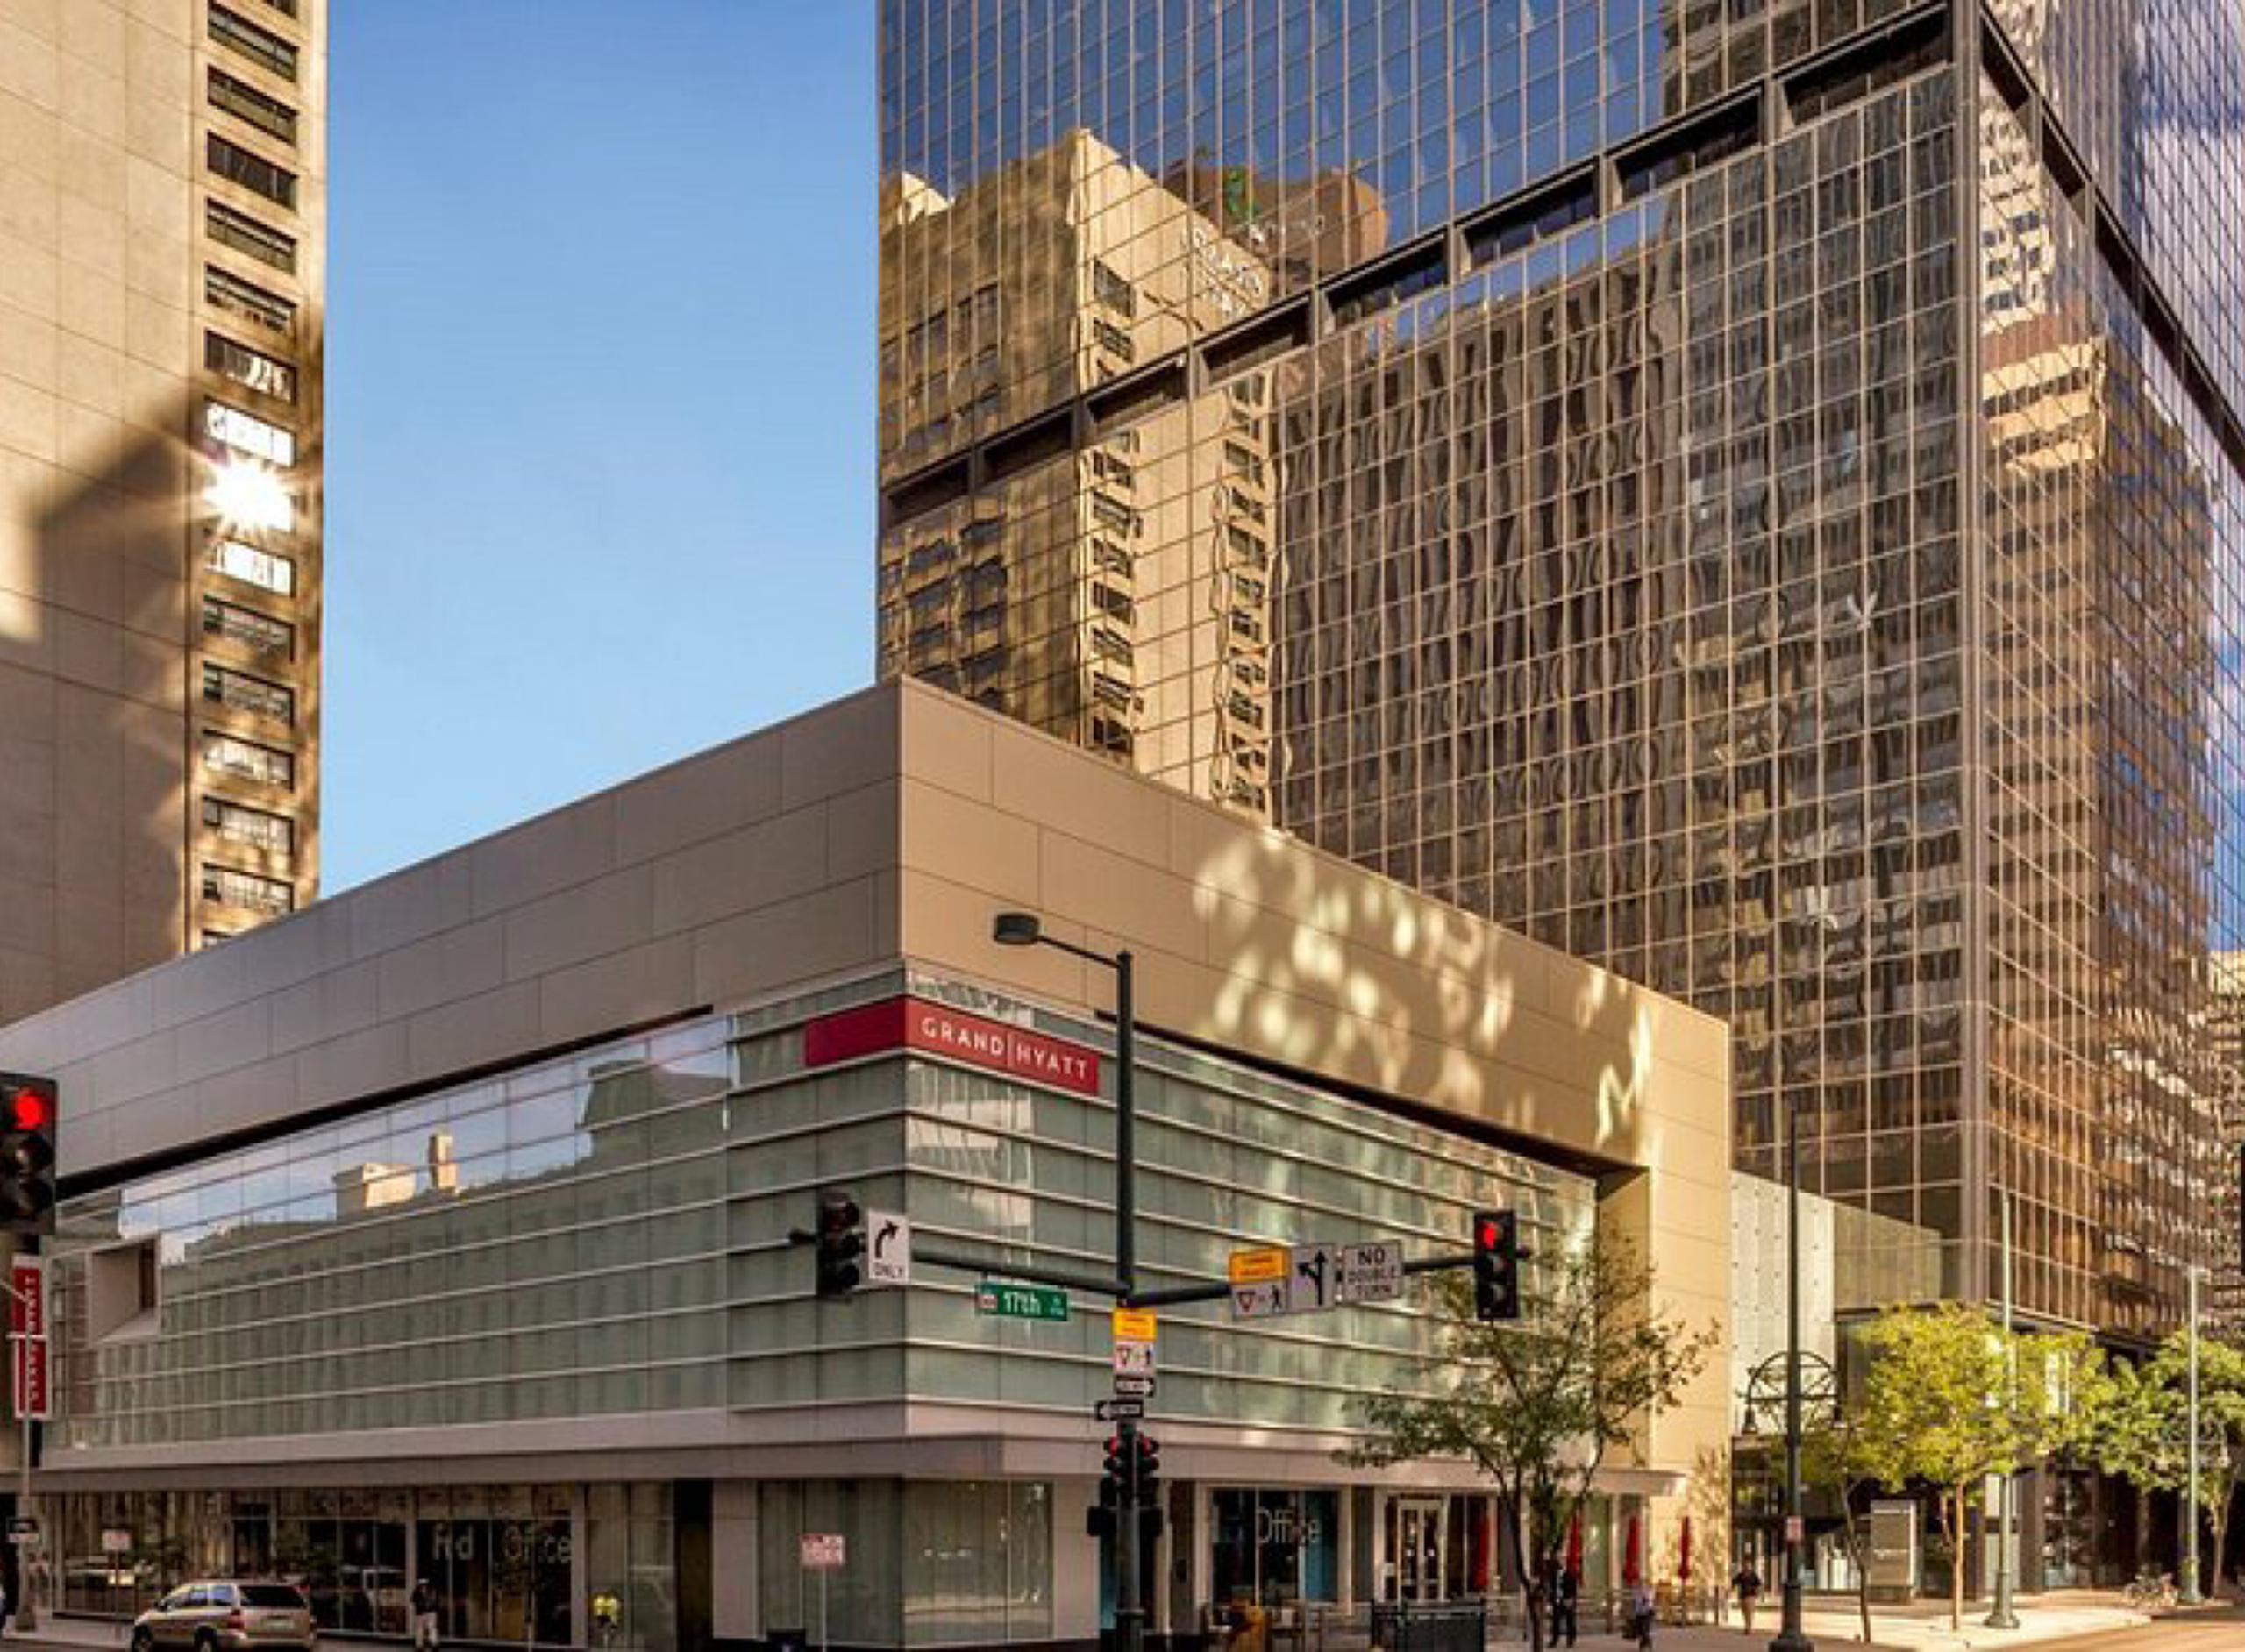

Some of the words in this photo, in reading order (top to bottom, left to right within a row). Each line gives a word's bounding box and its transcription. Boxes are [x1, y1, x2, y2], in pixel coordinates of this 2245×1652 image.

[921, 1017, 1005, 1056] GRAND
[1016, 1042, 1087, 1079] HYATT
[1358, 1246, 1385, 1266] NO
[1002, 1291, 1042, 1314] 17th
[1255, 1506, 1321, 1544] Offe
